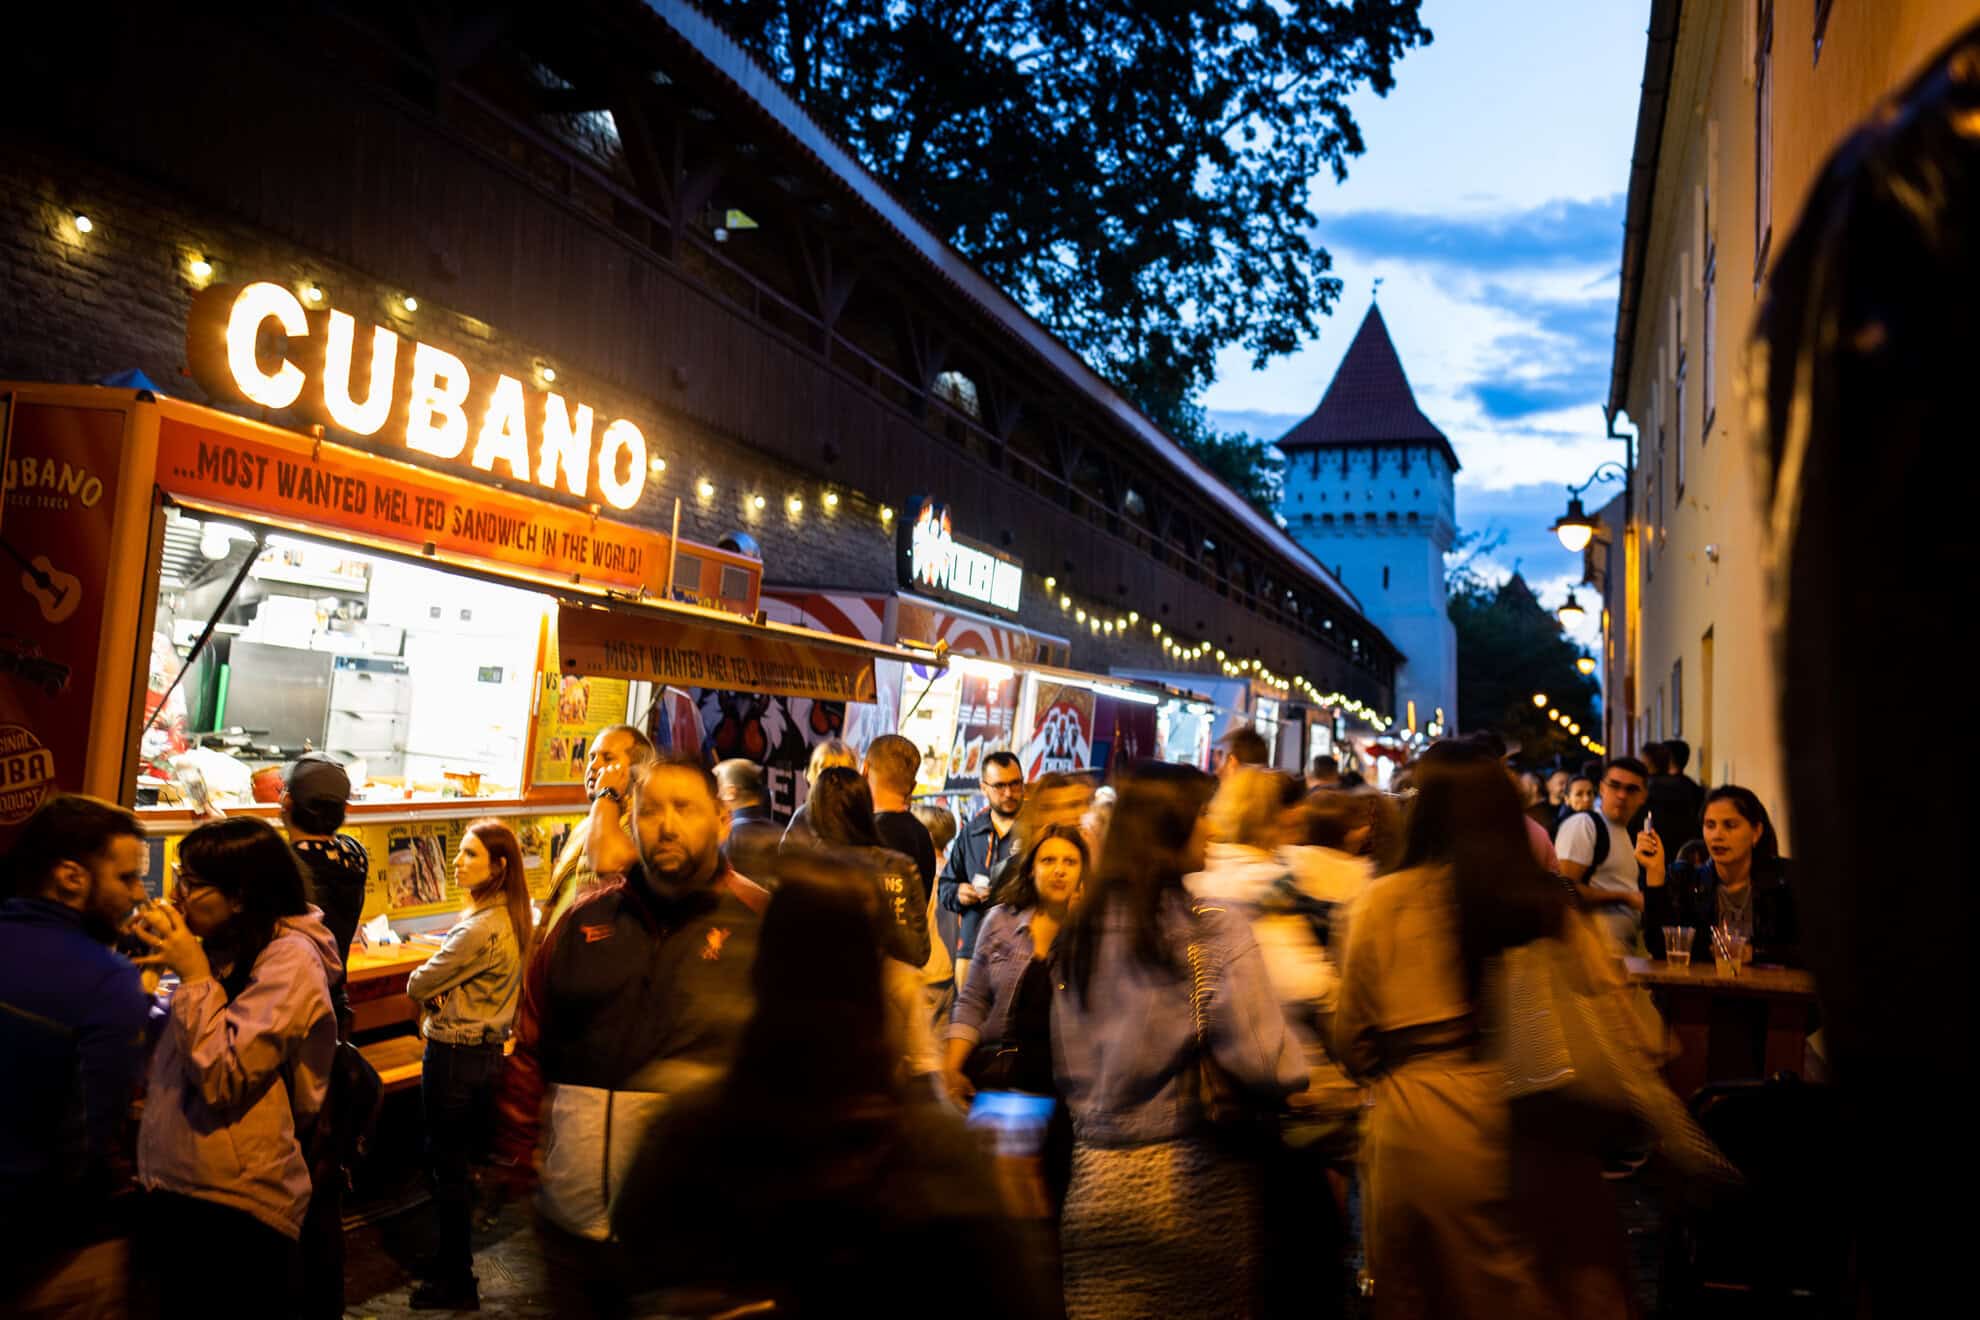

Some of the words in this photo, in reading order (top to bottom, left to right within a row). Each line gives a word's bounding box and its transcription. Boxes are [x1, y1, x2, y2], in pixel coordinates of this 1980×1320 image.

[225, 281, 648, 511] CUBANO
[173, 440, 268, 491] ...MOST
[276, 459, 368, 515] WANTED
[373, 484, 446, 532] MELTED
[451, 505, 538, 553] SANDWICH
[540, 527, 557, 556] IN
[562, 532, 588, 564] THE
[592, 539, 643, 576] WORLD!
[650, 646, 704, 680] WANTED
[705, 653, 751, 684] MELTED
